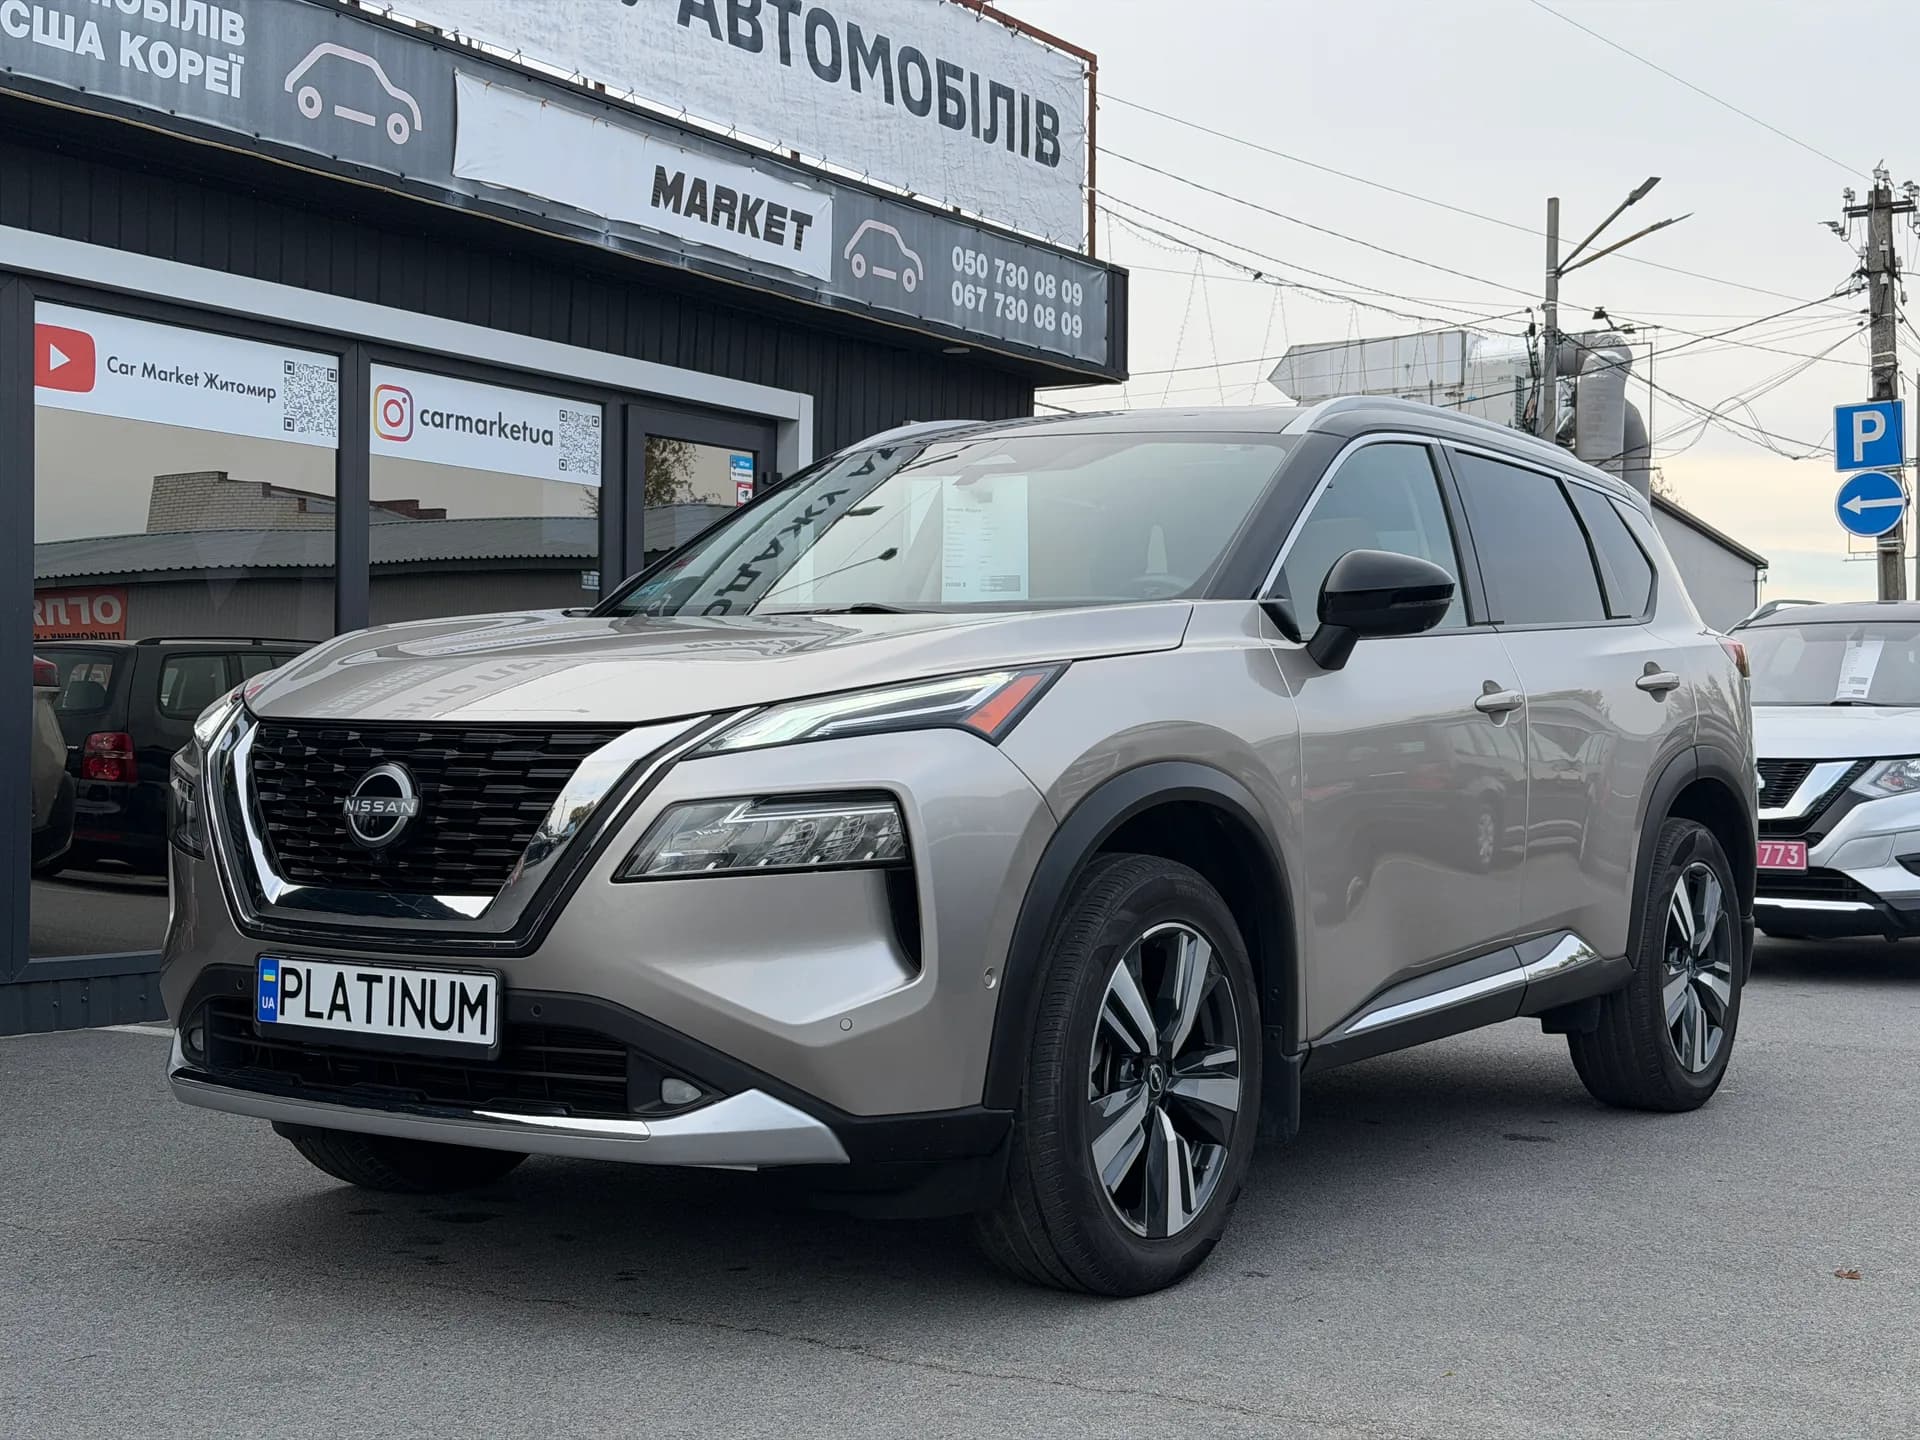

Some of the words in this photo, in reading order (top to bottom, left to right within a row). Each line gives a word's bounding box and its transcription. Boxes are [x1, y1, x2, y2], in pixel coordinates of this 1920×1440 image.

[0, 0, 106, 61] США
[119, 30, 245, 99] КОРЕЇ
[91, 0, 245, 46] БІЛІВ
[650, 165, 813, 252] MARKET
[952, 246, 988, 279] 050
[994, 258, 1029, 291] 730
[1034, 271, 1057, 299] 08
[1061, 279, 1083, 307] 09
[951, 280, 988, 313] 067
[994, 291, 1028, 324] 730
[1033, 303, 1056, 331] 08
[1060, 311, 1083, 338] 09
[106, 356, 137, 377] Car
[141, 362, 200, 387] Market
[203, 371, 278, 403] Житомир
[419, 406, 554, 447] carmarketua
[1852, 409, 1886, 462] P
[345, 799, 416, 814] NISSAN
[261, 995, 275, 1010] UA
[279, 966, 489, 1036] PLATINUM
